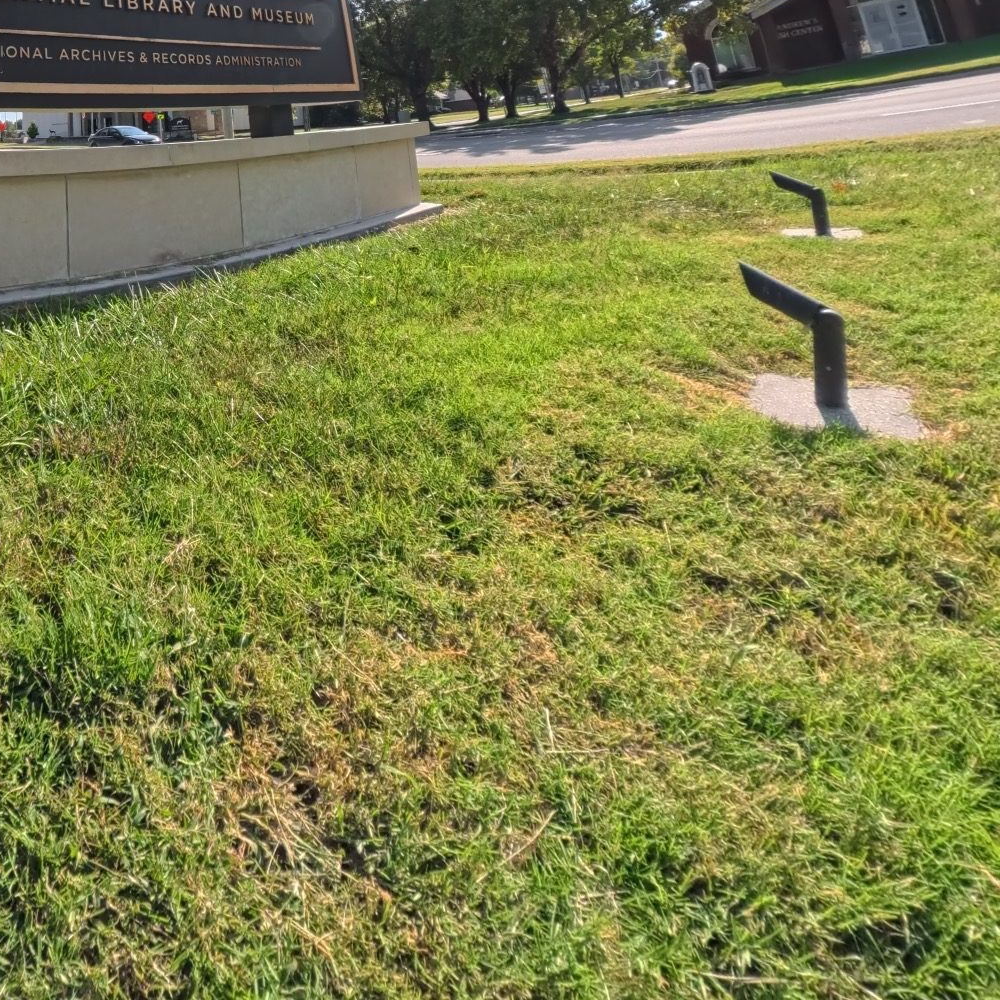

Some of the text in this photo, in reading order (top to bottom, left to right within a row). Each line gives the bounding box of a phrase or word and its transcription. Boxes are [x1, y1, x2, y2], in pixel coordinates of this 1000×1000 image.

[207, 3, 243, 19] AND
[251, 7, 315, 25] MUSEUM
[0, 45, 303, 68] IONAL ARCHIVES & RECORDS ADMINISTRATION
